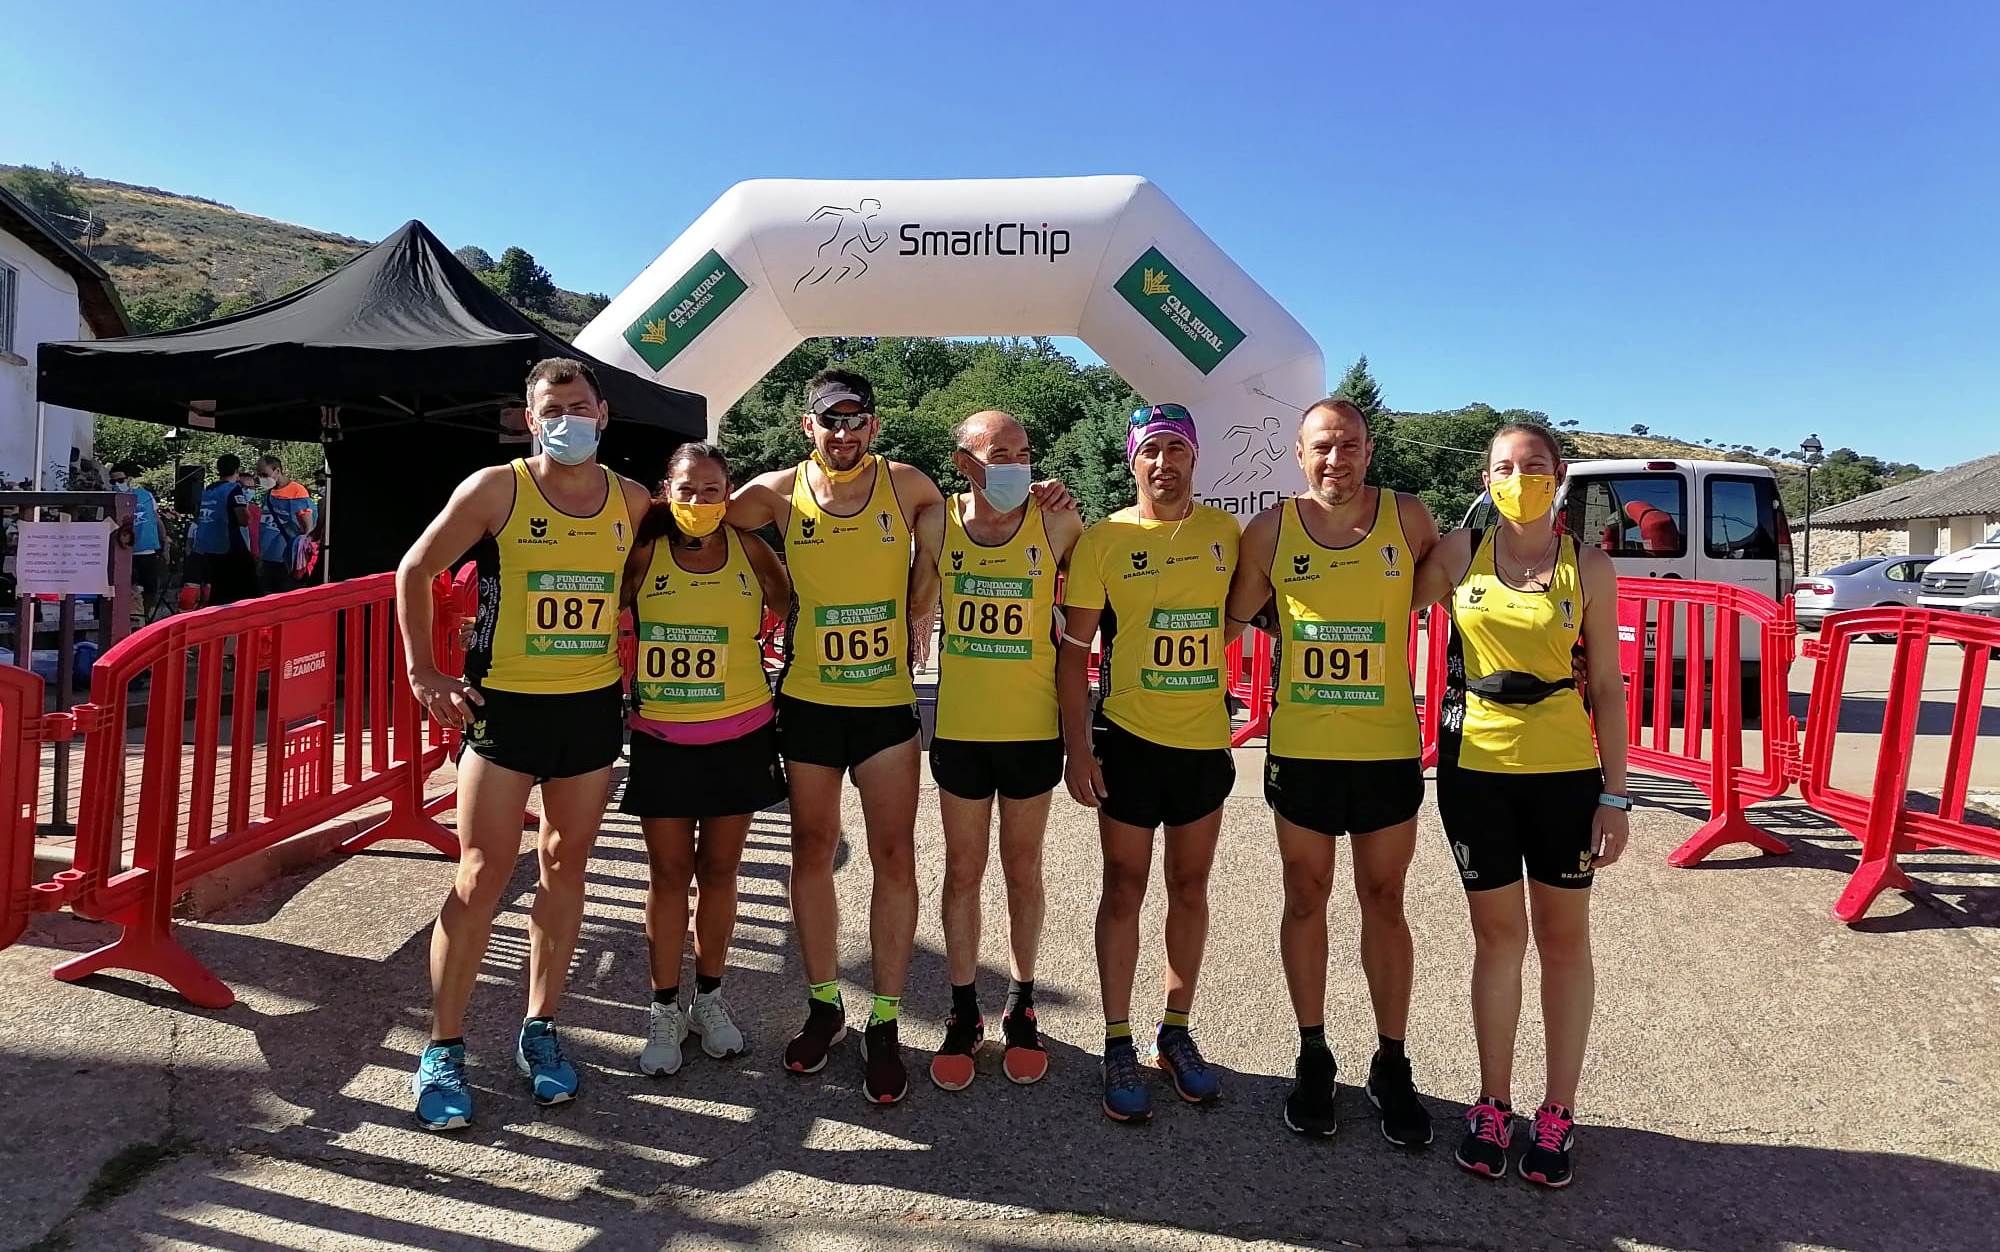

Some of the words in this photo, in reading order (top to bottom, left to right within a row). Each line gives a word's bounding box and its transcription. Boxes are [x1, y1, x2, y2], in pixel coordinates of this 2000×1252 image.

[899, 222, 1070, 263] SmartChip
[691, 268, 726, 302] RURAL
[675, 318, 688, 329] DE
[687, 292, 715, 320] ZAMORA
[1160, 303, 1171, 316] DE
[1170, 313, 1199, 341] ZAMORA
[1188, 316, 1223, 352] RURAL
[517, 538, 558, 546] BRAGANÇA
[1284, 574, 1321, 583] BRAGANÇA
[579, 583, 605, 591] RURAL
[537, 597, 605, 630] 087
[863, 612, 888, 623] RURAL
[958, 600, 1022, 635] 086
[1190, 619, 1211, 627] RURAL
[580, 641, 606, 649] RURAL
[824, 626, 889, 662] 065
[1343, 633, 1374, 641] RURAL
[994, 646, 1028, 654] RURAL
[1153, 633, 1209, 667] 061
[292, 658, 326, 677] ZAMORA
[646, 646, 716, 679] 088
[868, 664, 892, 677] RURAL
[1304, 647, 1369, 681] 091
[1190, 674, 1215, 684] RURAL
[687, 688, 720, 697] RURAL
[1344, 691, 1379, 700] RURAL
